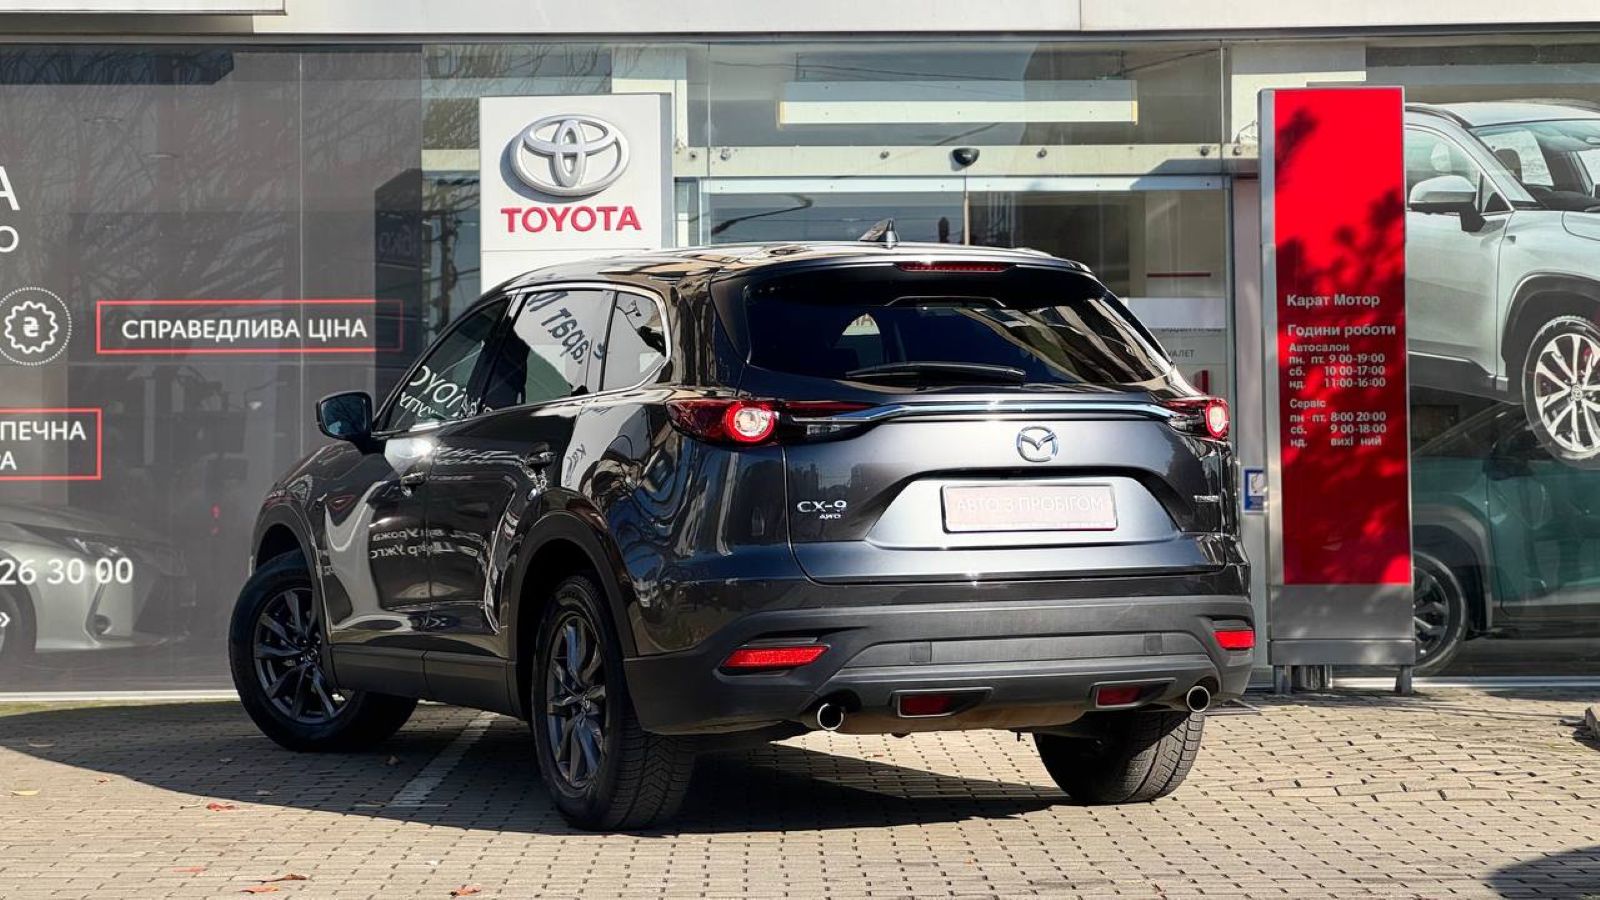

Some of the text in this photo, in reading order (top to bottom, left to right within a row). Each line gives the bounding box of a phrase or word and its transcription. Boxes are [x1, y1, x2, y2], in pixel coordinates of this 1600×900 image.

[501, 206, 641, 232] TOYOTA
[1286, 294, 1380, 309] Карат Мотор
[121, 318, 367, 342] СПРАВЕДЛИВА ЦІНА
[1287, 323, 1396, 338] Години роботи
[1289, 343, 1350, 352] Автосалон
[1289, 399, 1326, 410] Сервіс
[796, 499, 847, 513] CX-9
[958, 497, 1000, 513] АВТО
[1018, 495, 1103, 512] ПРОБІГОМ
[0, 557, 133, 585] 26 30 00
